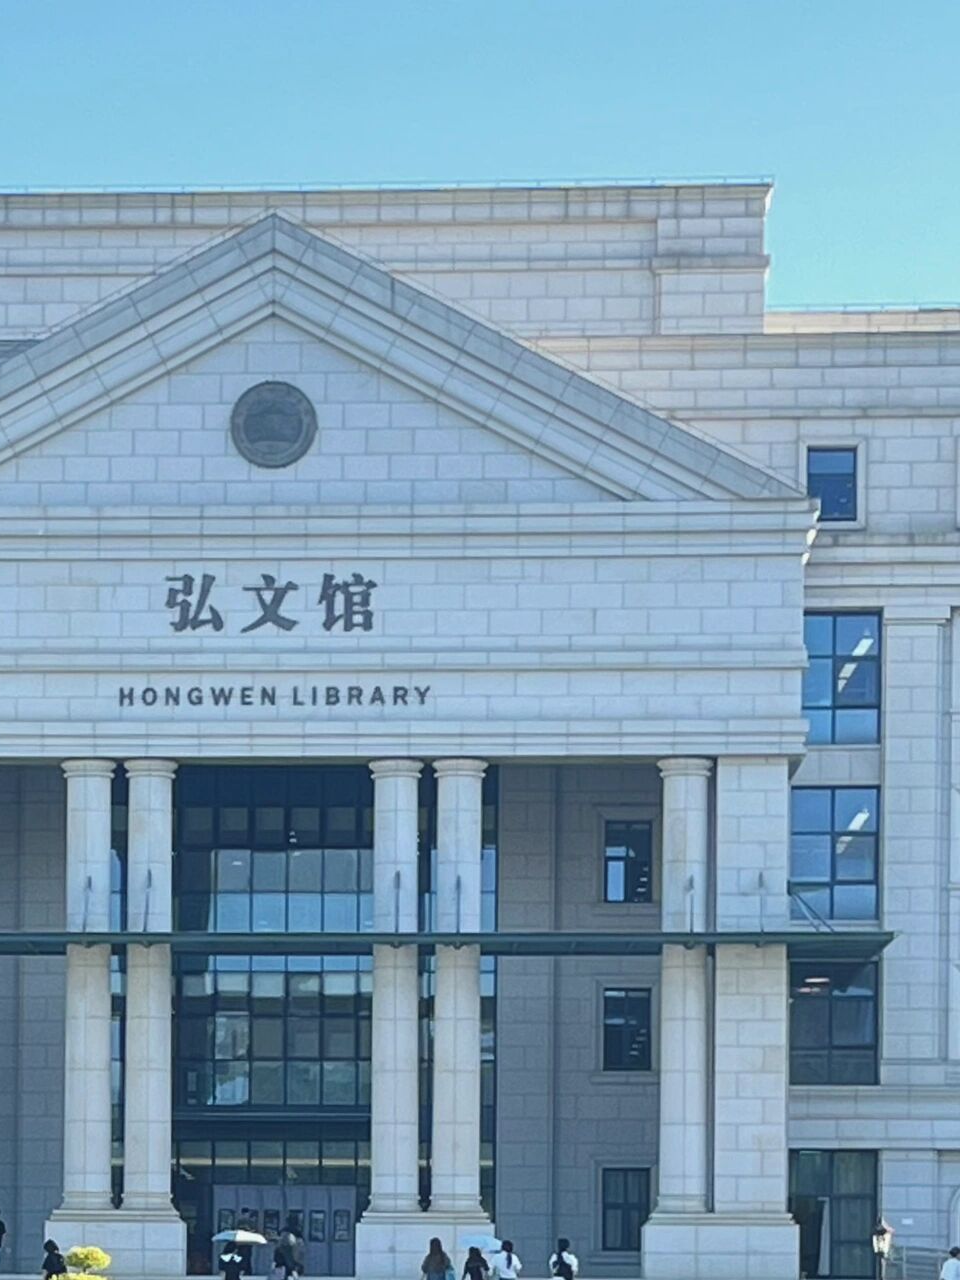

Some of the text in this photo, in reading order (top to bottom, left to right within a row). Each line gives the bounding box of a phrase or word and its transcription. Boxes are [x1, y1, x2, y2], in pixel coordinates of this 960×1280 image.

[165, 573, 377, 634] 弘文馆
[119, 684, 431, 708] HONGWEN LIBRARY
